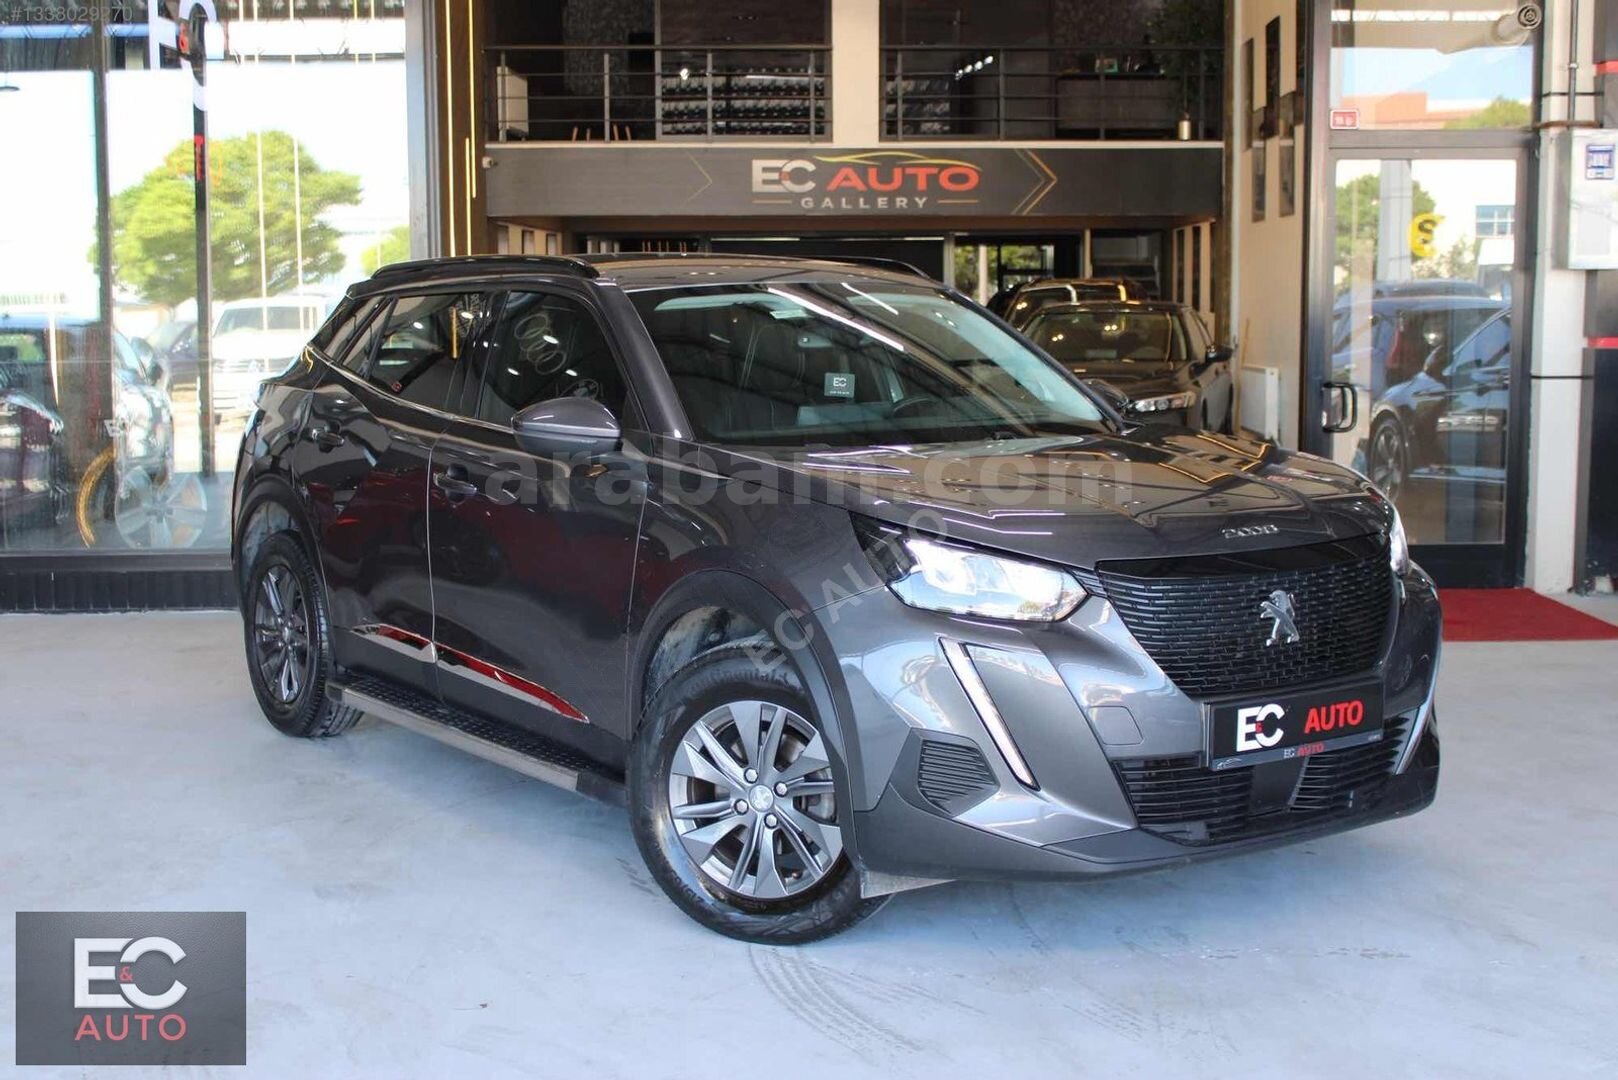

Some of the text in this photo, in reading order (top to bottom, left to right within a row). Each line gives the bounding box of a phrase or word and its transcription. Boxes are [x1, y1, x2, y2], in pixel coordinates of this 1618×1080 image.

[826, 166, 980, 192] AUTO
[801, 197, 928, 209] GALLERY
[1221, 524, 1279, 539] 2008
[1304, 700, 1364, 734] AUTO
